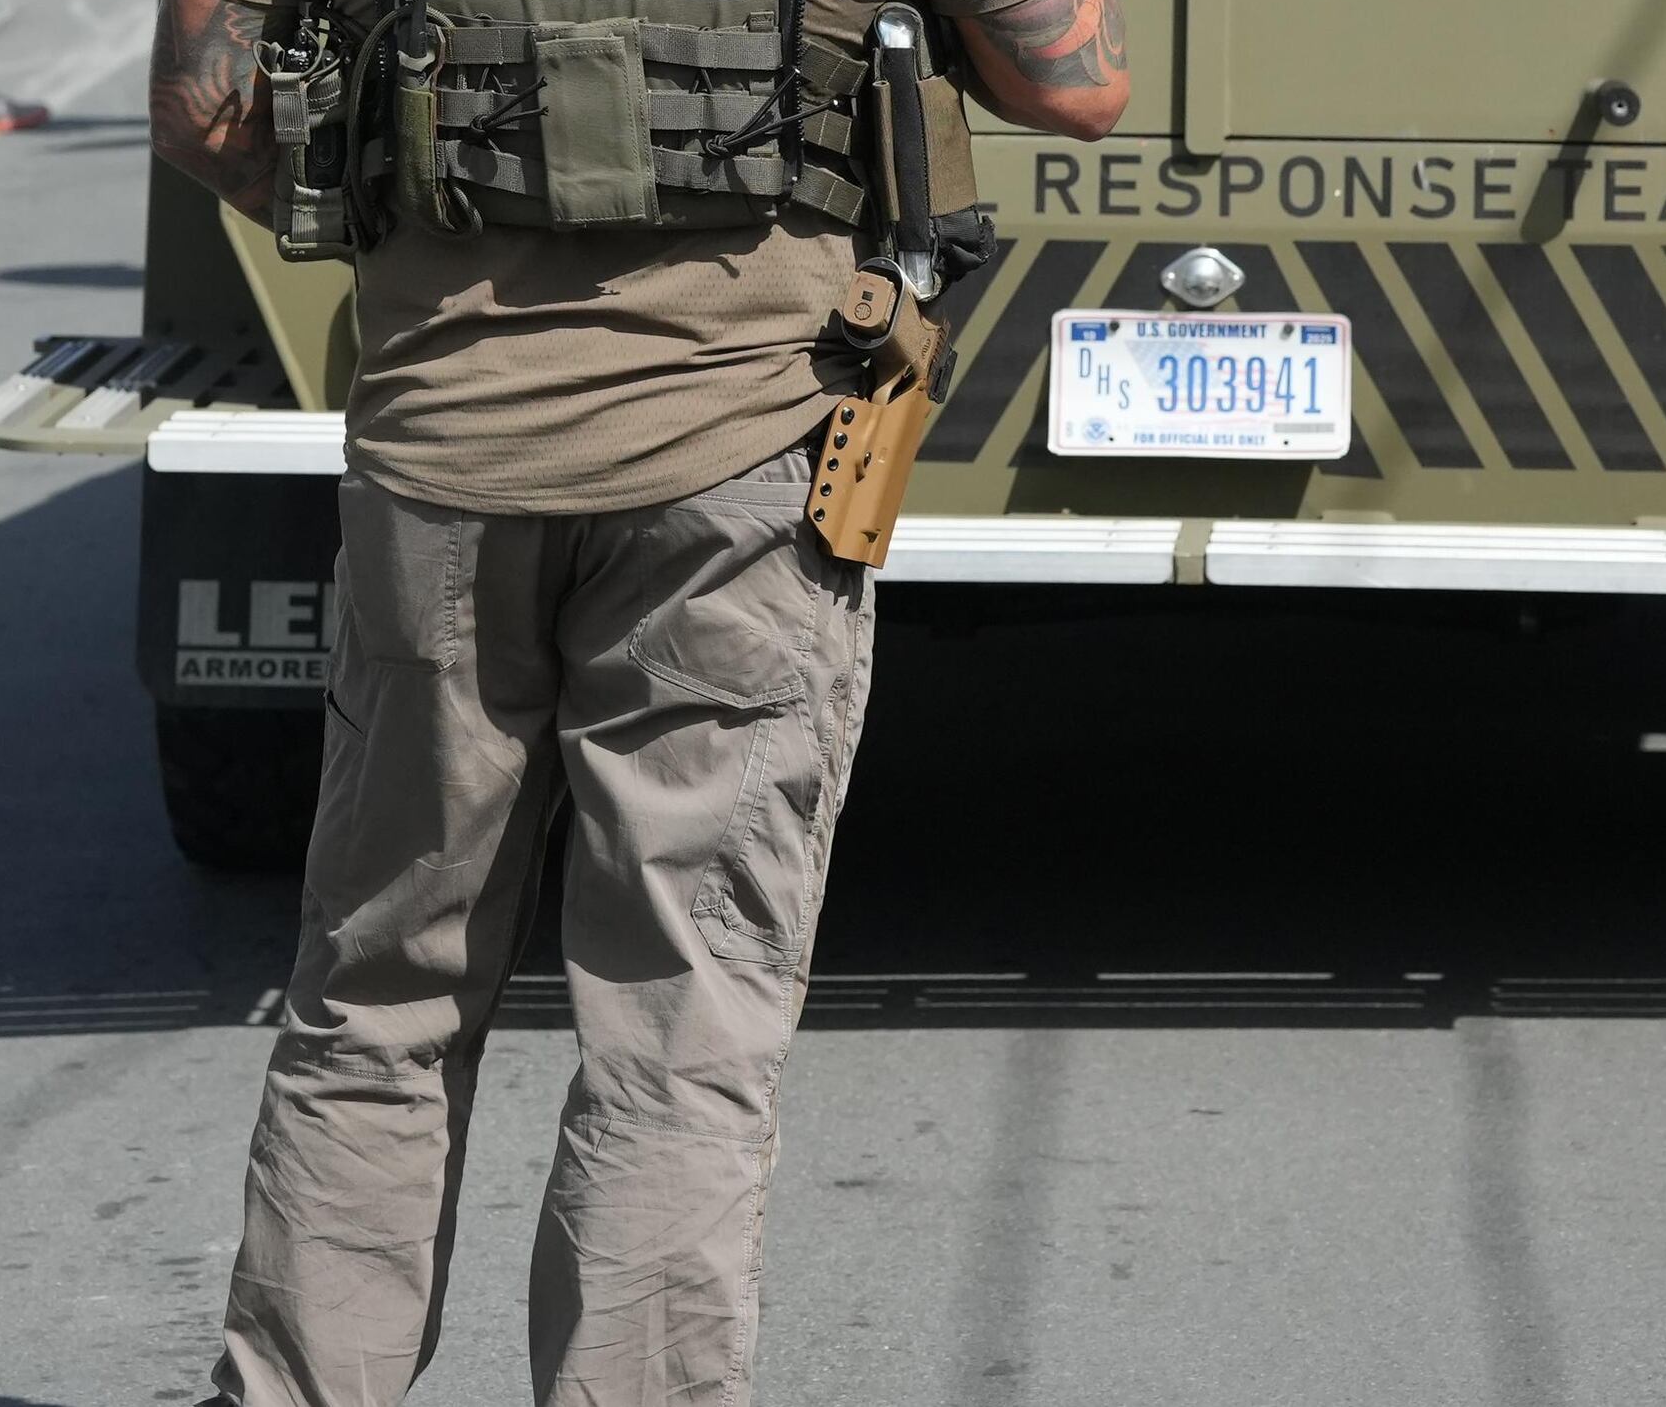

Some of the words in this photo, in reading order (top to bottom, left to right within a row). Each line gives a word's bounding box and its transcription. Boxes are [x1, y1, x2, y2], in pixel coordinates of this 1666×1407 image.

[1035, 152, 1517, 220] RESPONSE
[1137, 323, 1161, 338] U.S.
[1168, 323, 1267, 339] GOVERNMENT
[1157, 355, 1321, 414] 303941
[1134, 433, 1154, 444] FOR
[1159, 433, 1209, 445] OFFICIAL
[1213, 434, 1233, 445] USE
[1238, 435, 1265, 446] ONLY
[178, 579, 335, 647] LE
[181, 657, 323, 680] ARMORE
